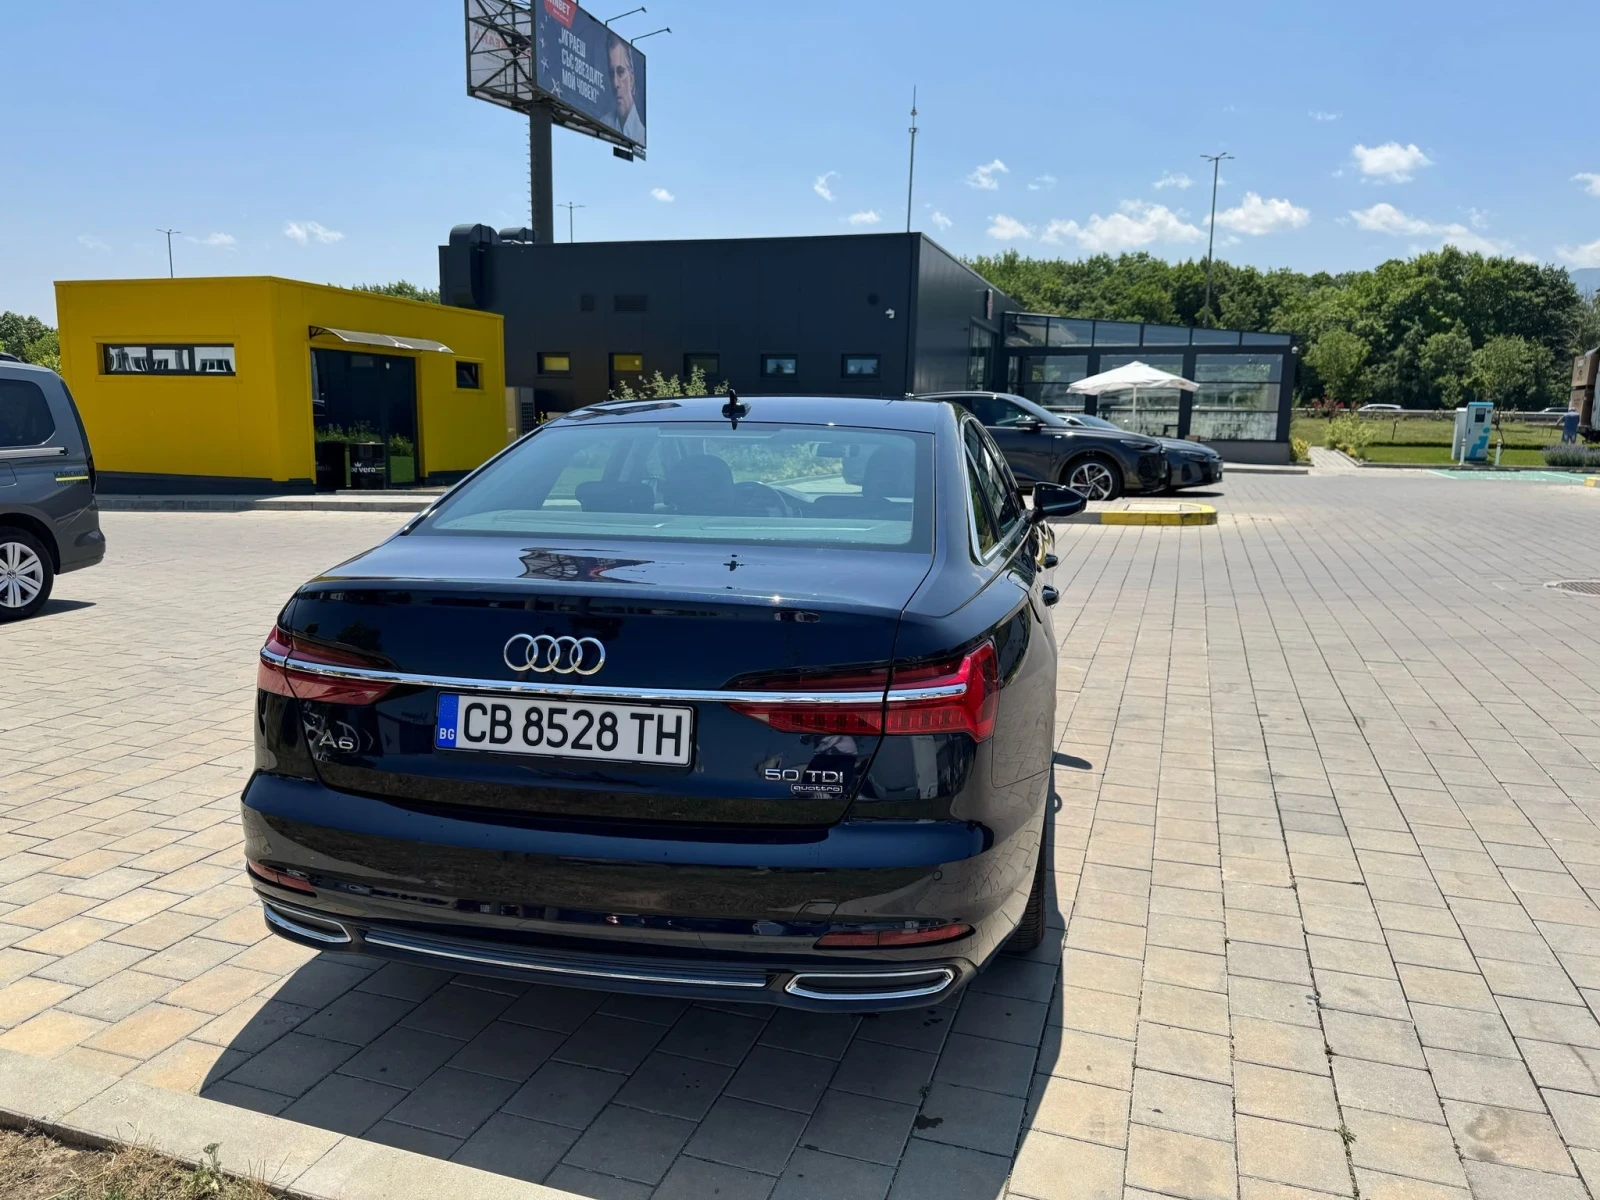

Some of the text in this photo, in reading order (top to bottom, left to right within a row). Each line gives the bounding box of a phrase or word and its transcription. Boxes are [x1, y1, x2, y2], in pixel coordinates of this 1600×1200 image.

[561, 48, 574, 70] СЪС
[562, 68, 576, 91] МОЙ
[318, 729, 355, 750] A6
[439, 727, 455, 741] BG
[463, 702, 683, 757] CB 8528 TH
[764, 768, 844, 783] 50 TDI
[792, 784, 842, 793] quattro
